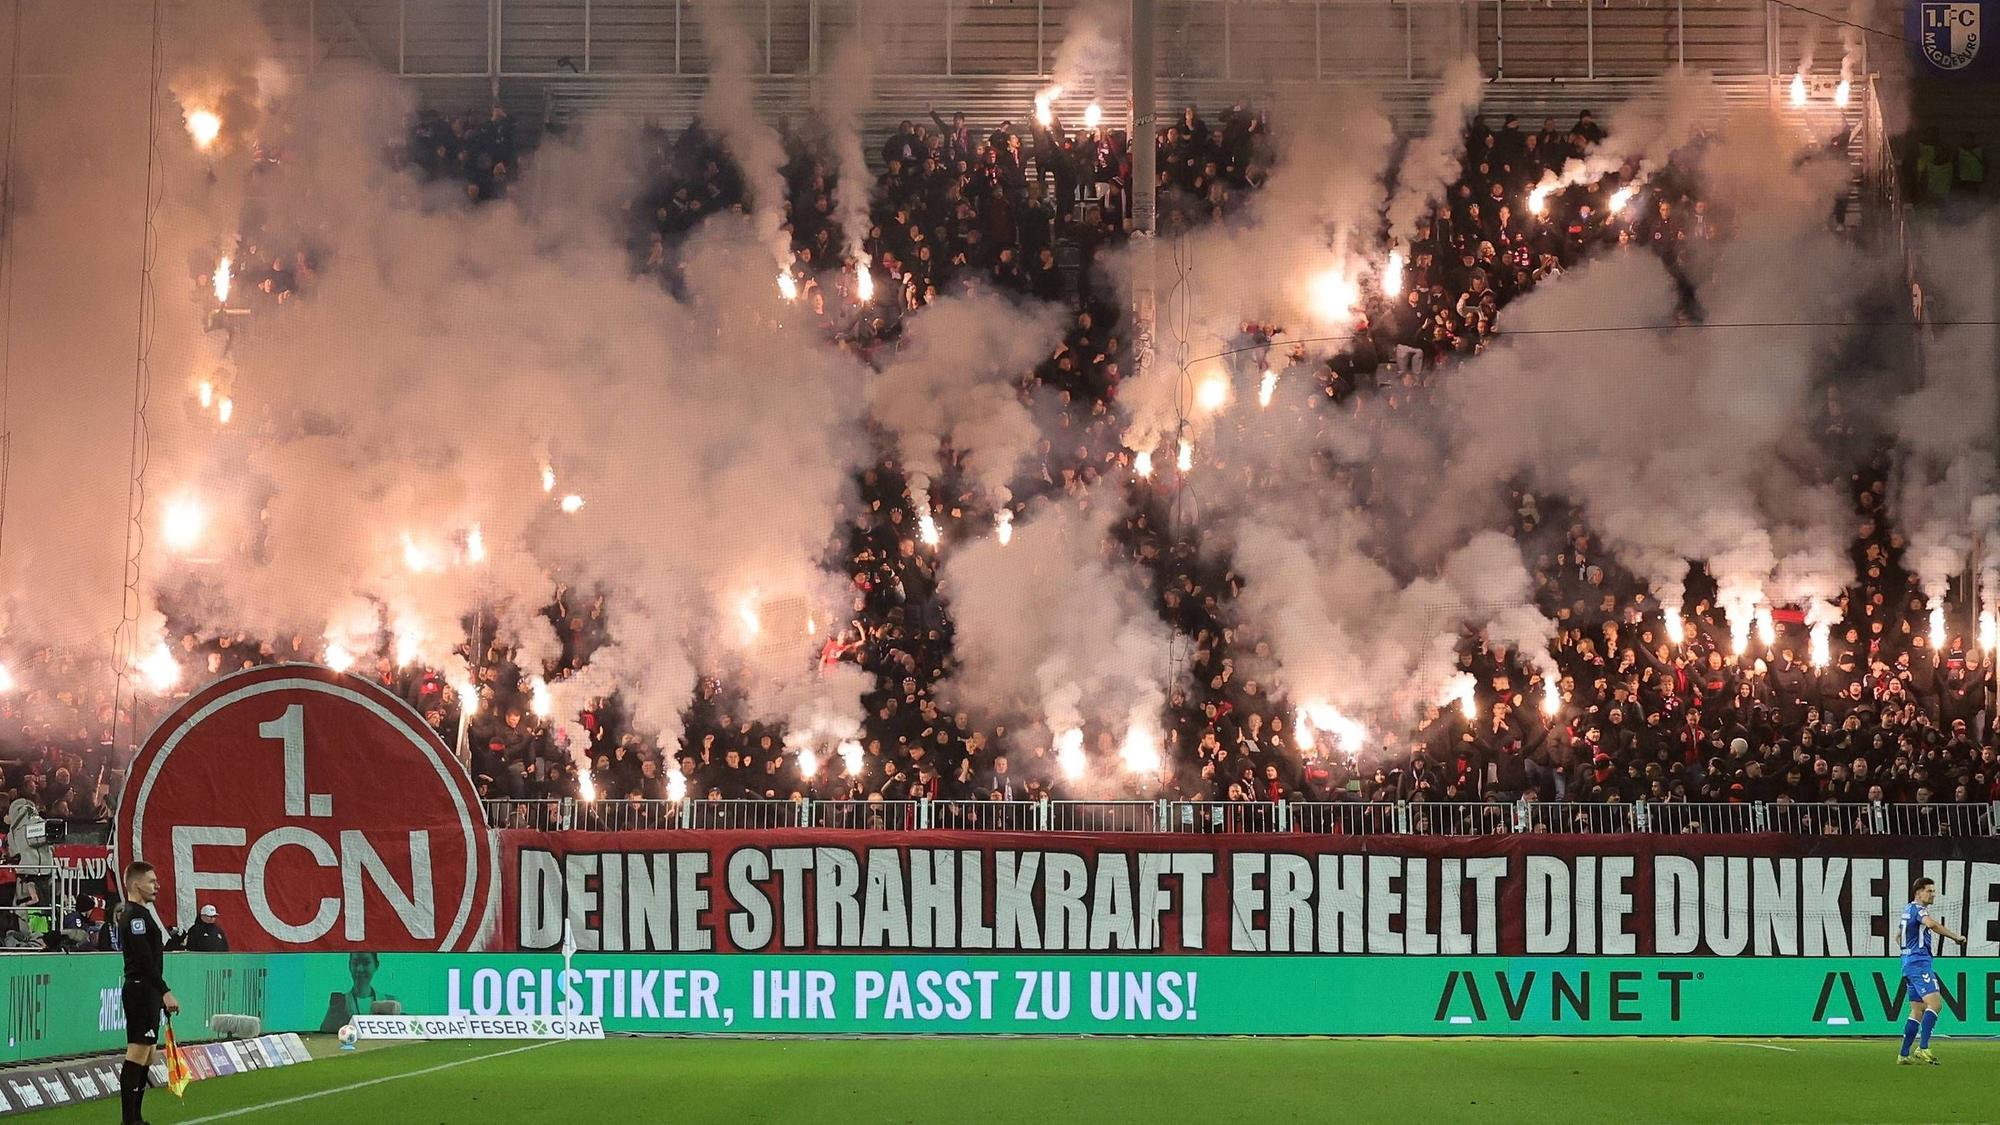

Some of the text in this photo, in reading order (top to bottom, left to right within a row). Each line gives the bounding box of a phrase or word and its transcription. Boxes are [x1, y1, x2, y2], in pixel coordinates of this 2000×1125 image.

[1924, 32, 1977, 68] MAGDEBURG
[258, 703, 334, 817] 1.
[171, 825, 436, 943] FCN
[518, 846, 713, 953] DEINE
[726, 845, 1215, 951] STRAHLKRAFT
[1230, 851, 1509, 956] ERHELLT
[1525, 854, 1638, 956] DIE
[447, 967, 1198, 1027] LOGISTIKER, IHR PASST ZU UNS!
[357, 1020, 467, 1035] FESER GRAF
[469, 1020, 600, 1035] FESER GRAF
